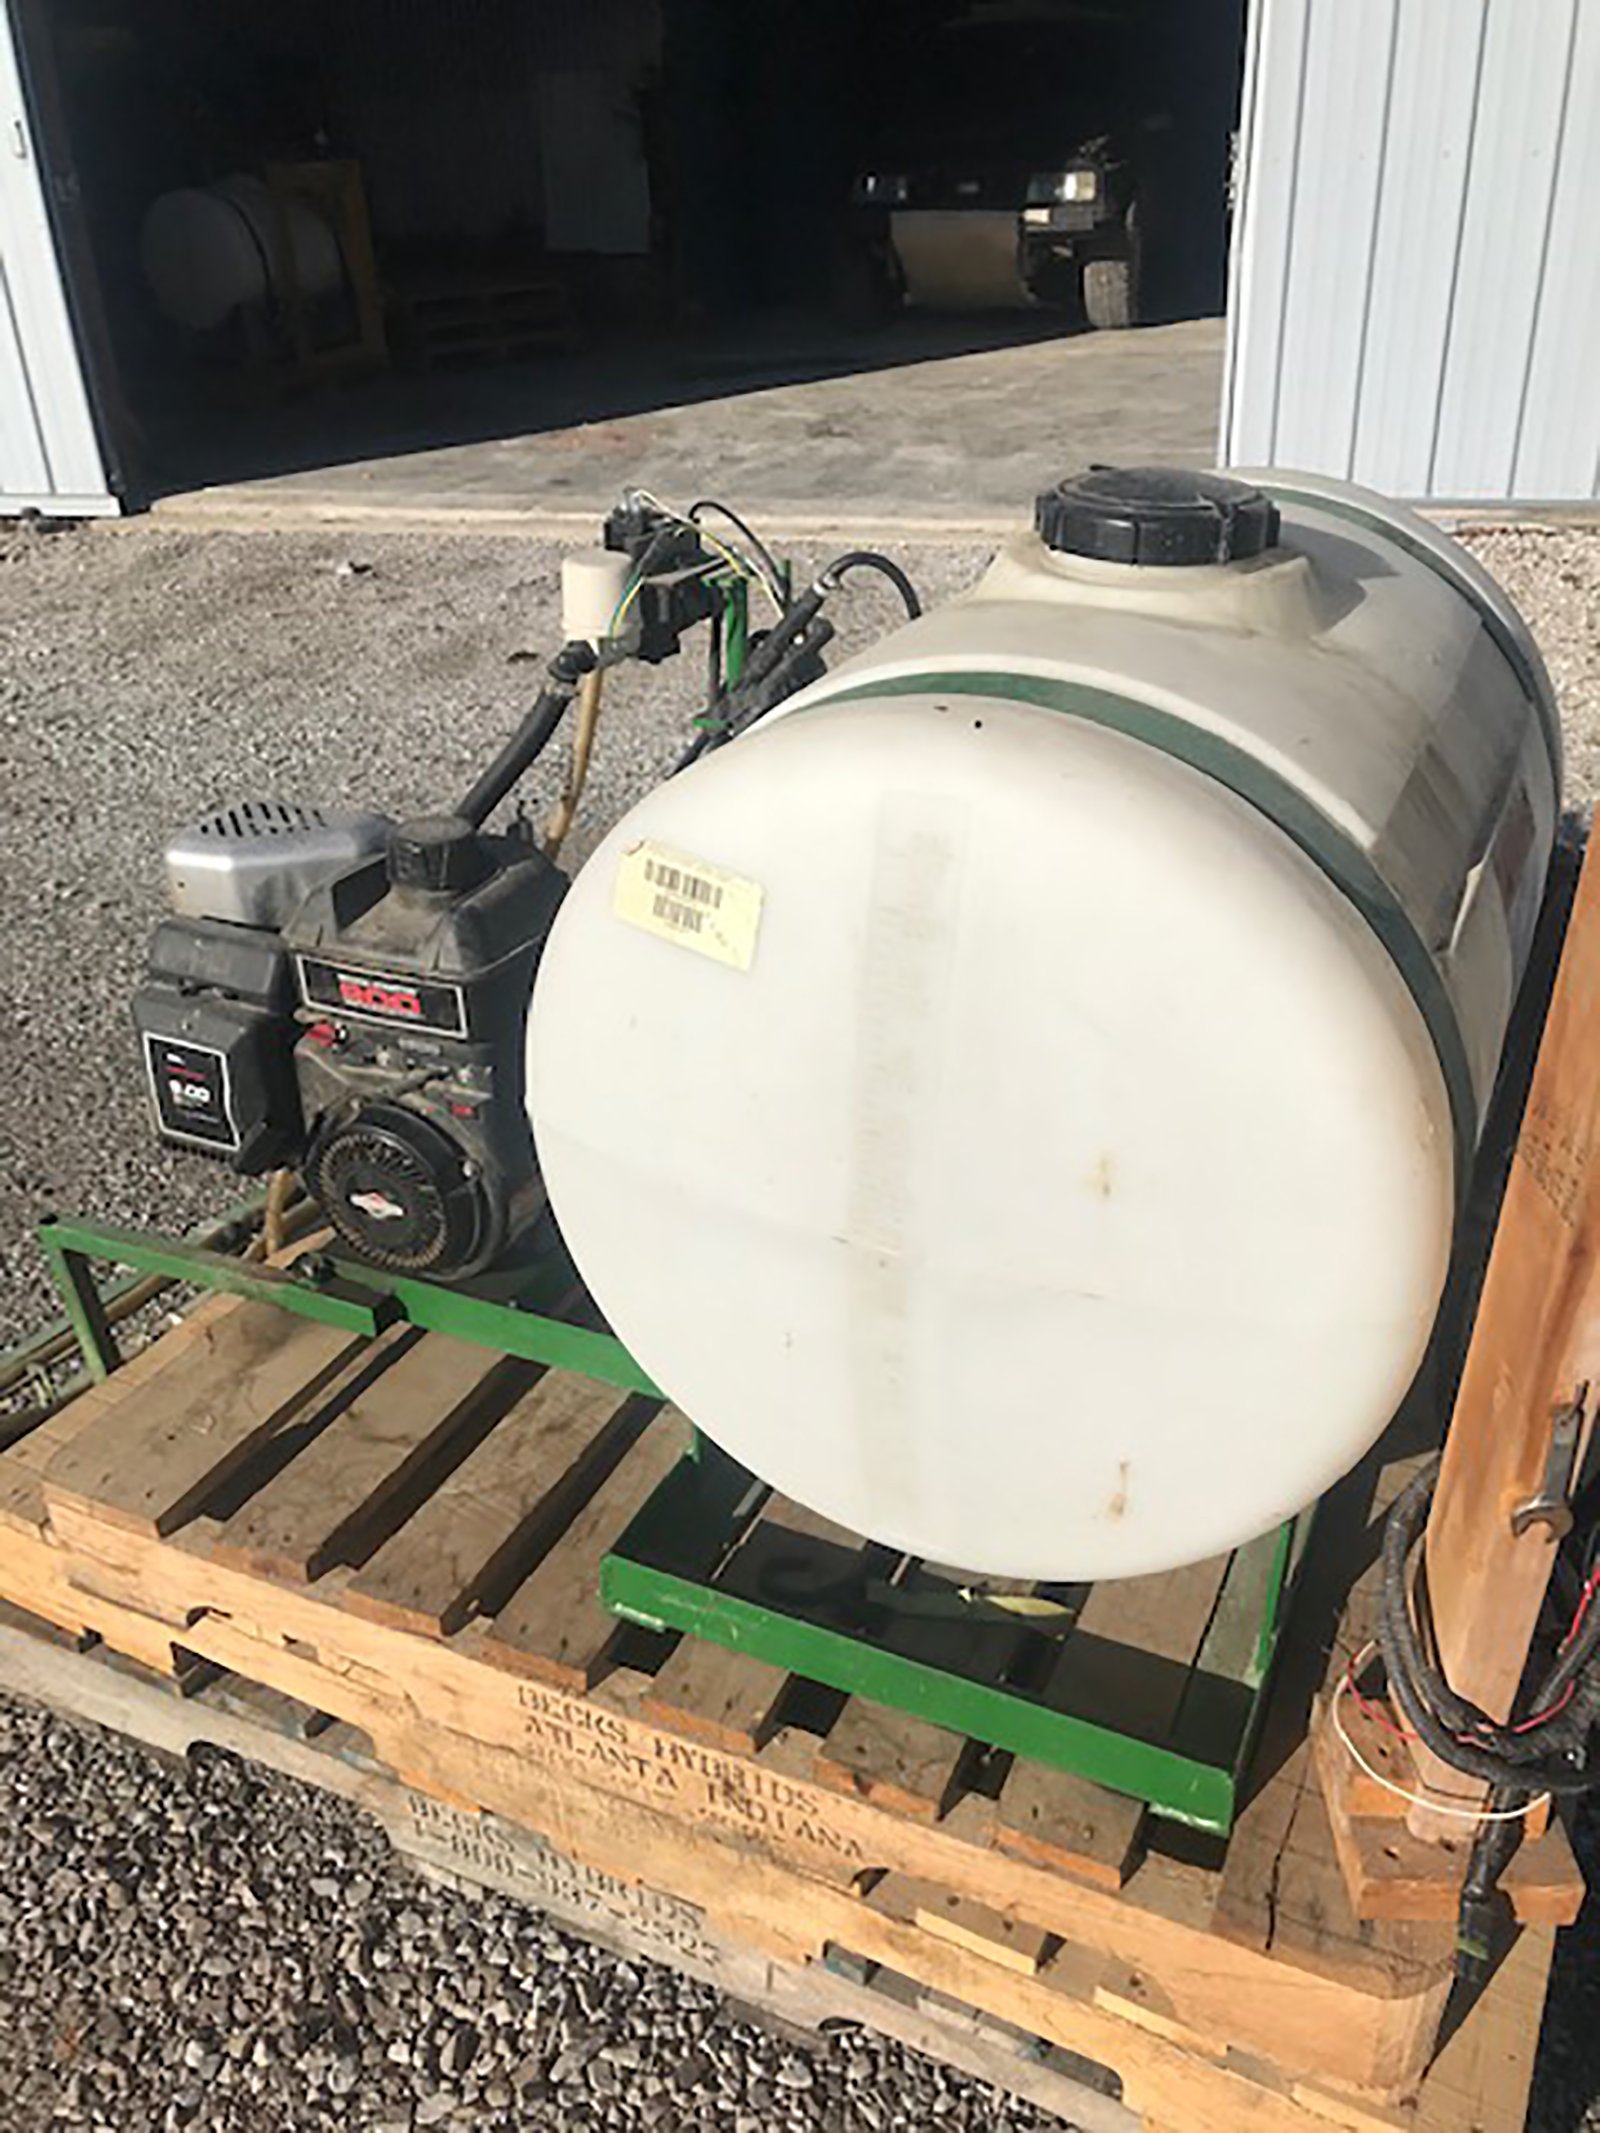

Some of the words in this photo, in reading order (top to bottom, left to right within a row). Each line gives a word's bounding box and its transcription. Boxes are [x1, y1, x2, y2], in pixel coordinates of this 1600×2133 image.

[517, 1685, 629, 1745] BECKS
[654, 1736, 819, 1816] HYBRIDS
[525, 1715, 679, 1791] ATLANTA
[706, 1782, 863, 1859] INDIANA
